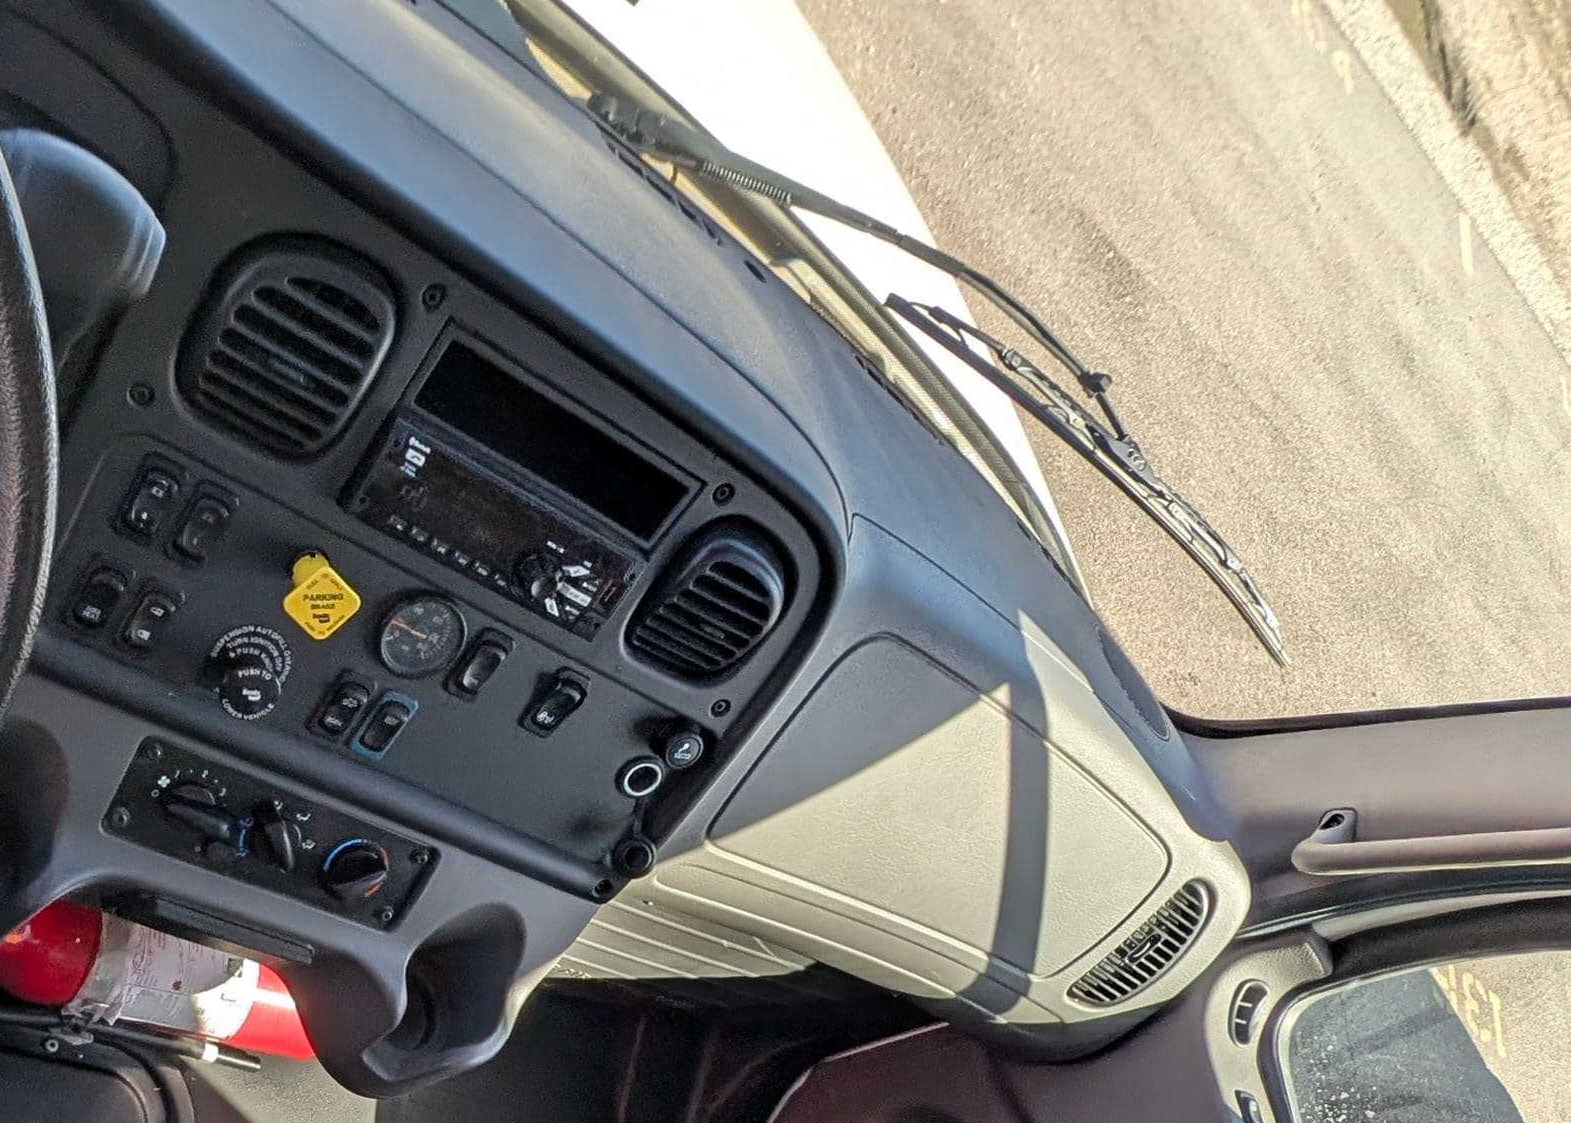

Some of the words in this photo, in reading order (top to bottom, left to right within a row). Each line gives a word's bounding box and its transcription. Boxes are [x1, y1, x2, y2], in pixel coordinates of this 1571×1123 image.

[302, 593, 344, 602] PARKING
[261, 670, 272, 680] TO
[222, 698, 243, 718] LOWER
